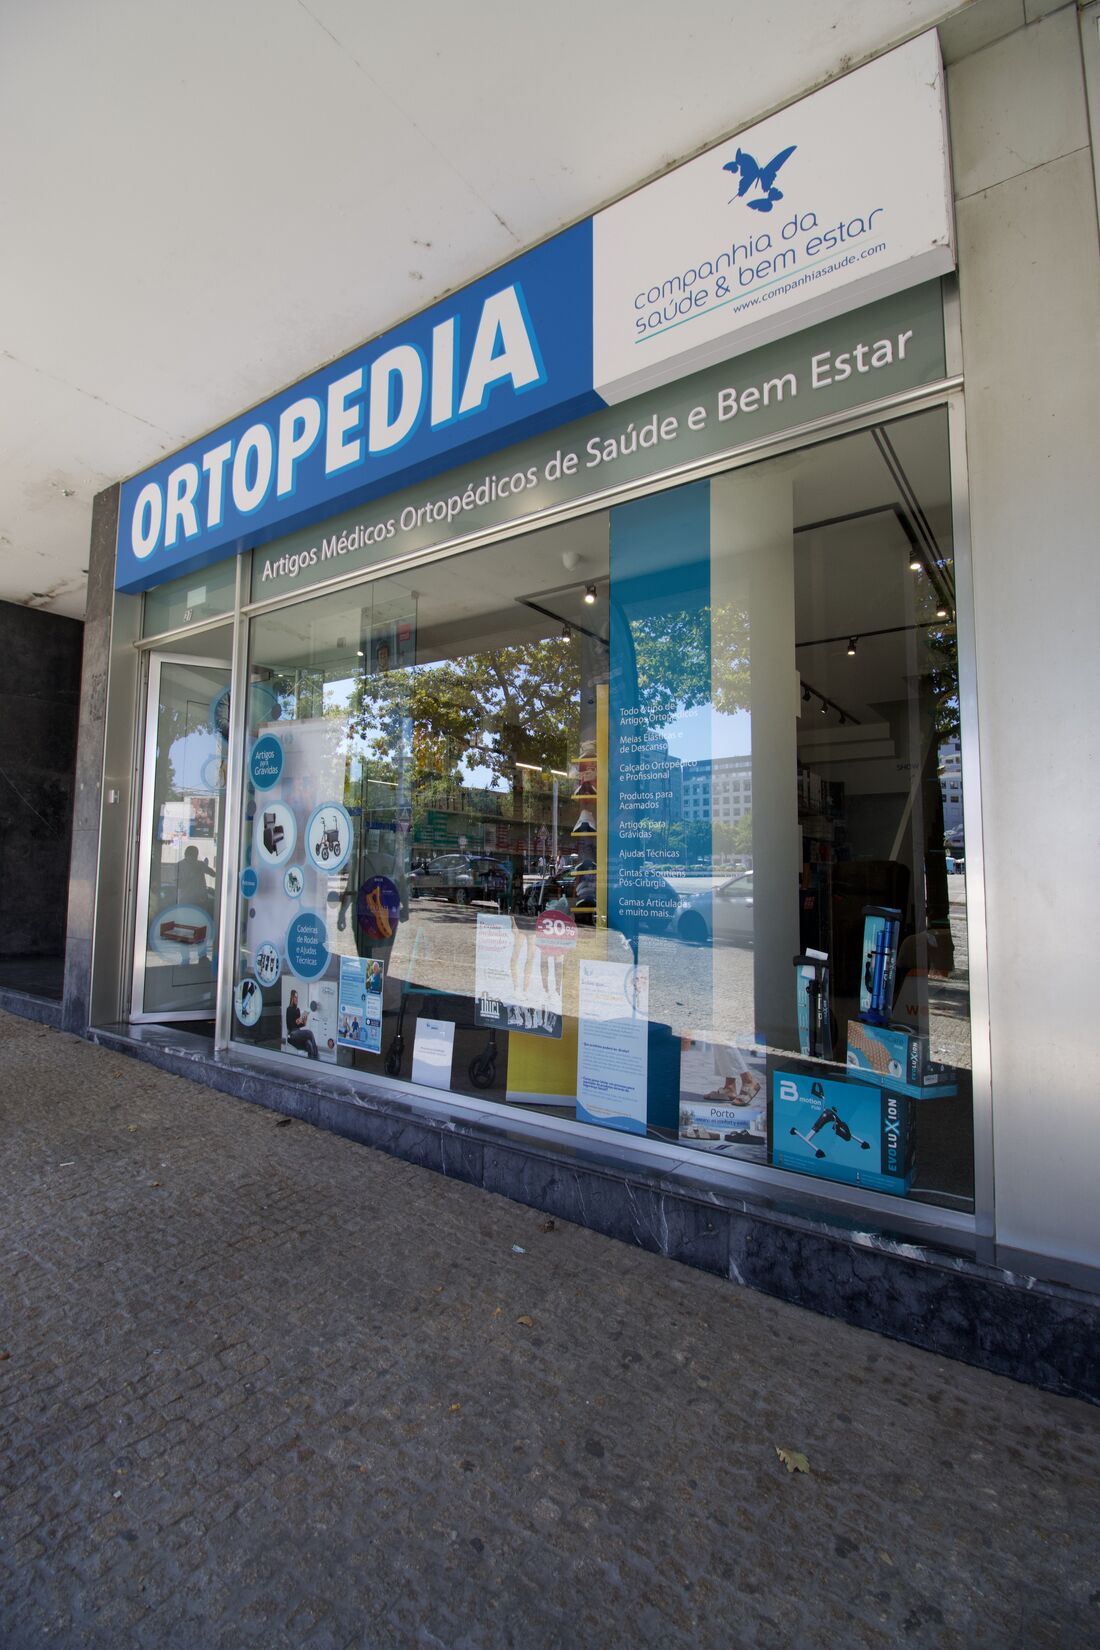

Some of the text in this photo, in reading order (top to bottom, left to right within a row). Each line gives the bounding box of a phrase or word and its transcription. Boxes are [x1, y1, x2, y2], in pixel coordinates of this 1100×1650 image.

[634, 211, 819, 310] companhia da
[635, 208, 884, 334] saúde & bem estar
[732, 241, 887, 314] www.companhiasaude.com
[131, 283, 544, 560] ORTOPEDIA
[261, 329, 914, 581] Artigos Médicos Ortopédicos de Saúde e Bem Estar
[620, 707, 639, 716] Todo
[647, 704, 663, 713] tipo
[664, 702, 676, 710] de
[620, 716, 648, 726] Artigos
[620, 735, 642, 744] Meias
[619, 742, 668, 753] de Descanso
[255, 751, 275, 760] Artigos
[619, 760, 698, 773] Calçado Ortopédico
[626, 771, 670, 781] Profissional
[619, 790, 673, 800] Produtos para
[619, 801, 660, 810] Acamados
[619, 820, 666, 830] Artigos para
[619, 830, 652, 838] Grávidas
[619, 848, 680, 859] Ajudas Técnicas
[619, 868, 643, 877] Cintas
[618, 897, 691, 909] Camas Articuladas
[625, 908, 649, 917] muito
[650, 909, 676, 918] mais...
[296, 924, 318, 934] Cadeiras
[296, 934, 319, 945] de Rodas
[300, 946, 317, 956] Ajudas
[296, 956, 317, 966] Técnicas
[799, 1096, 822, 1106] motion
[710, 1108, 735, 1118] Porto
[885, 1098, 900, 1172] EVOLUXION
